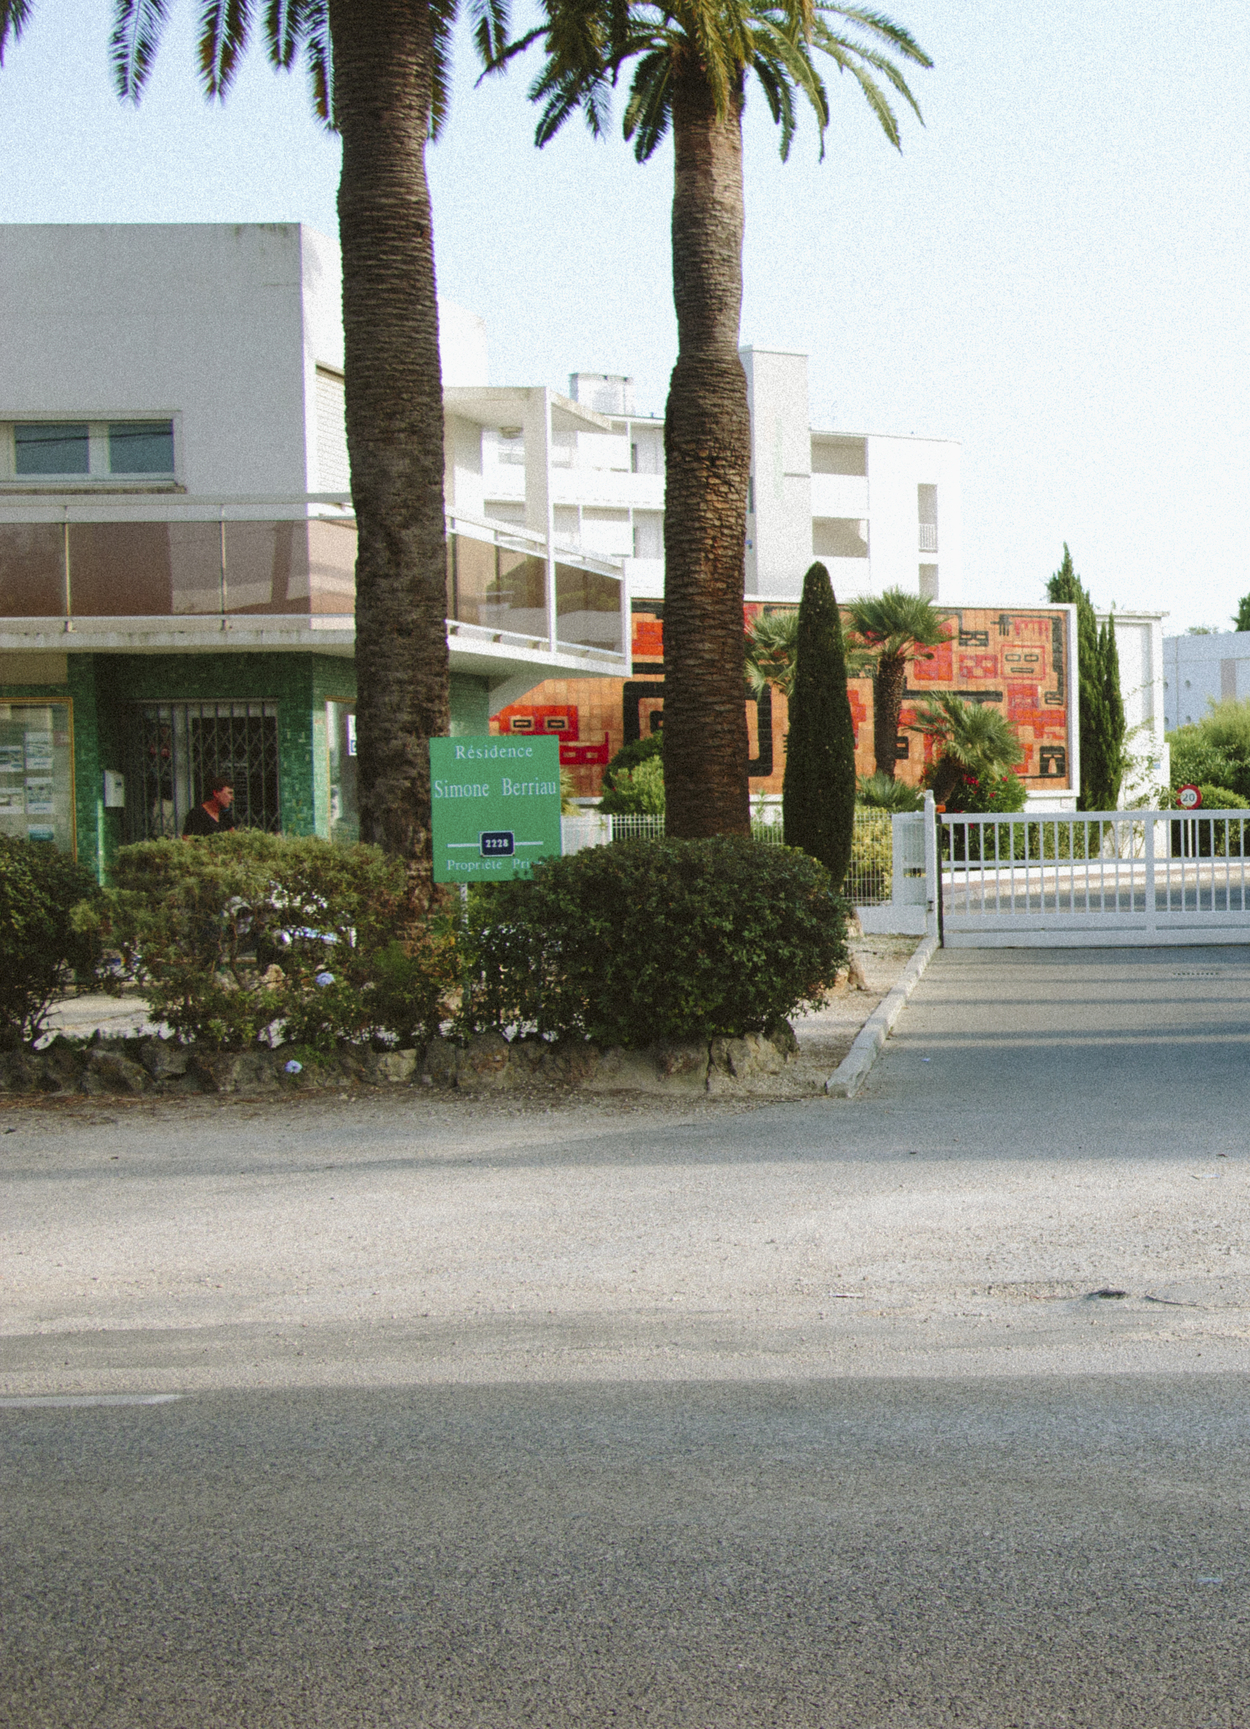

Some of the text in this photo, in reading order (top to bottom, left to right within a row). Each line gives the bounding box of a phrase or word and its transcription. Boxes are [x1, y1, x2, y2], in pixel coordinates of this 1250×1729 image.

[455, 745, 533, 760] Résidence
[434, 777, 556, 798] Simone Berriau
[1182, 793, 1196, 802] 20
[485, 839, 509, 848] 2228
[446, 859, 502, 872] Propriété
